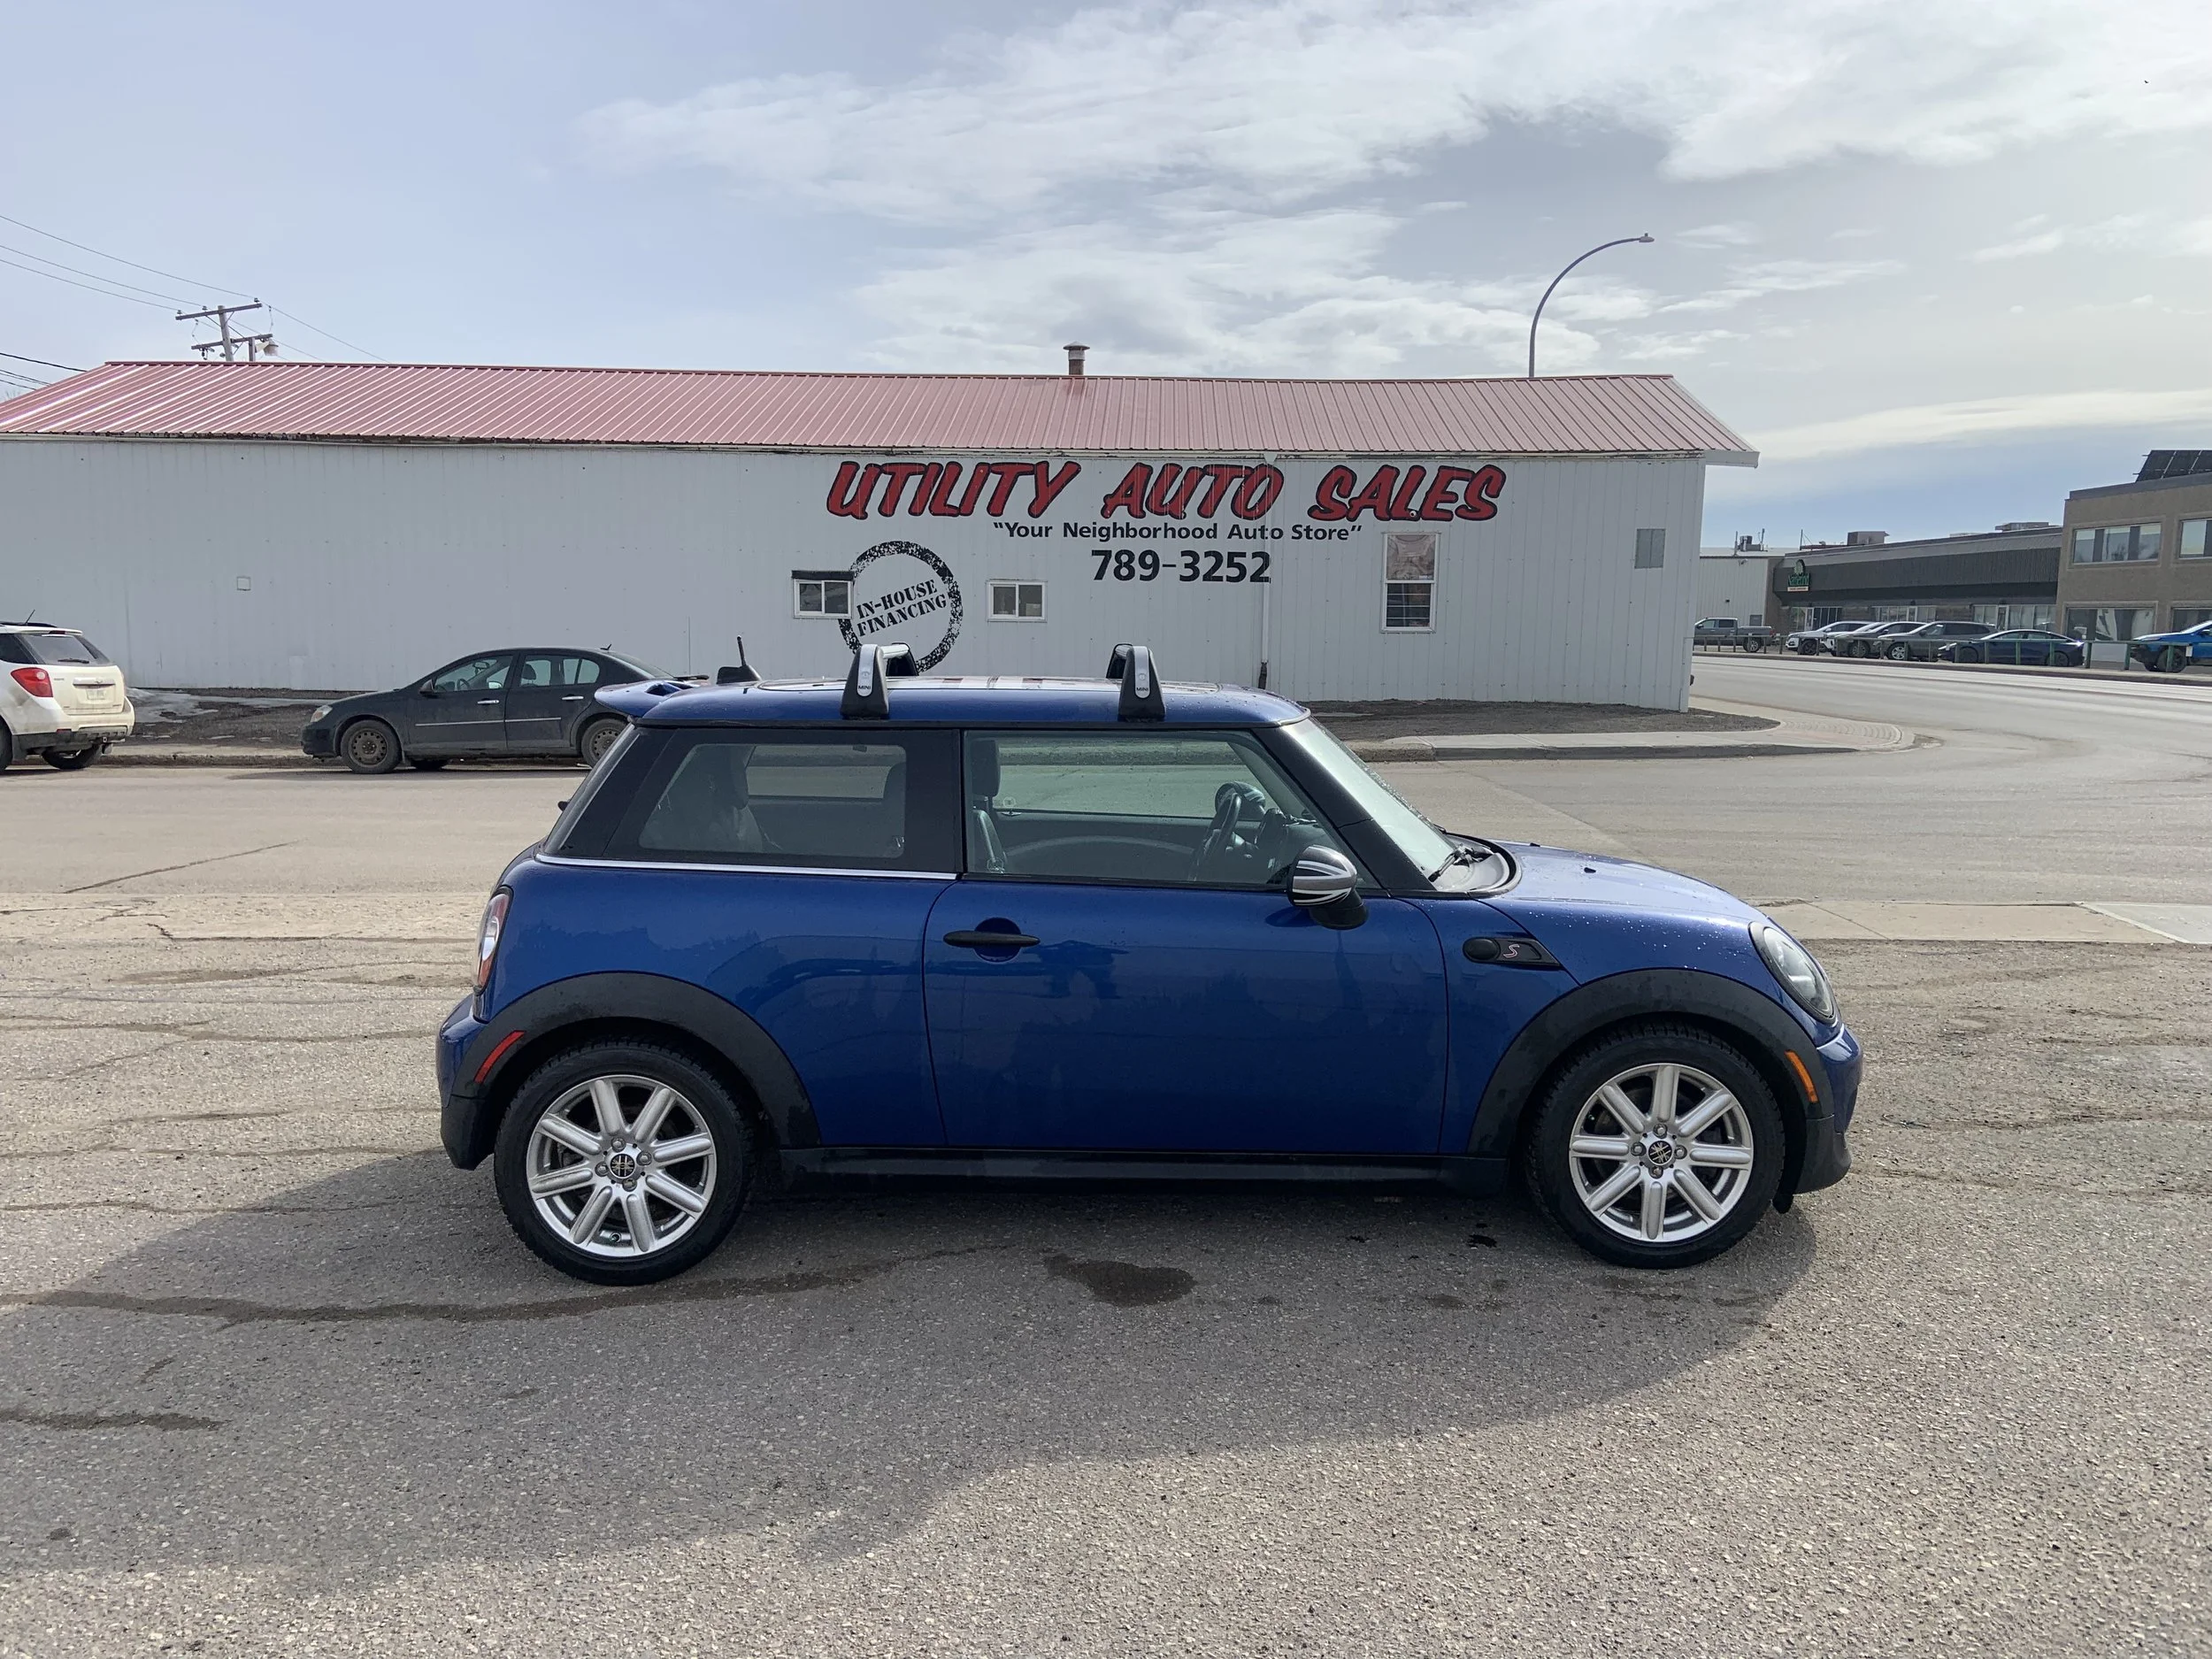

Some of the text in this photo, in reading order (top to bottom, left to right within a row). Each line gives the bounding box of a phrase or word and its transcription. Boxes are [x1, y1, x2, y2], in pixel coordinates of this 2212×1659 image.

[826, 461, 1507, 522] UTILITY AUTO SALES
[1063, 522, 1217, 542] Neighborhood
[1227, 524, 1283, 540] Auto
[1091, 549, 1271, 583] 789-3252
[856, 580, 938, 619] IN-HOUSE
[856, 594, 947, 637] FINANCING
[1502, 943, 1520, 958] S
